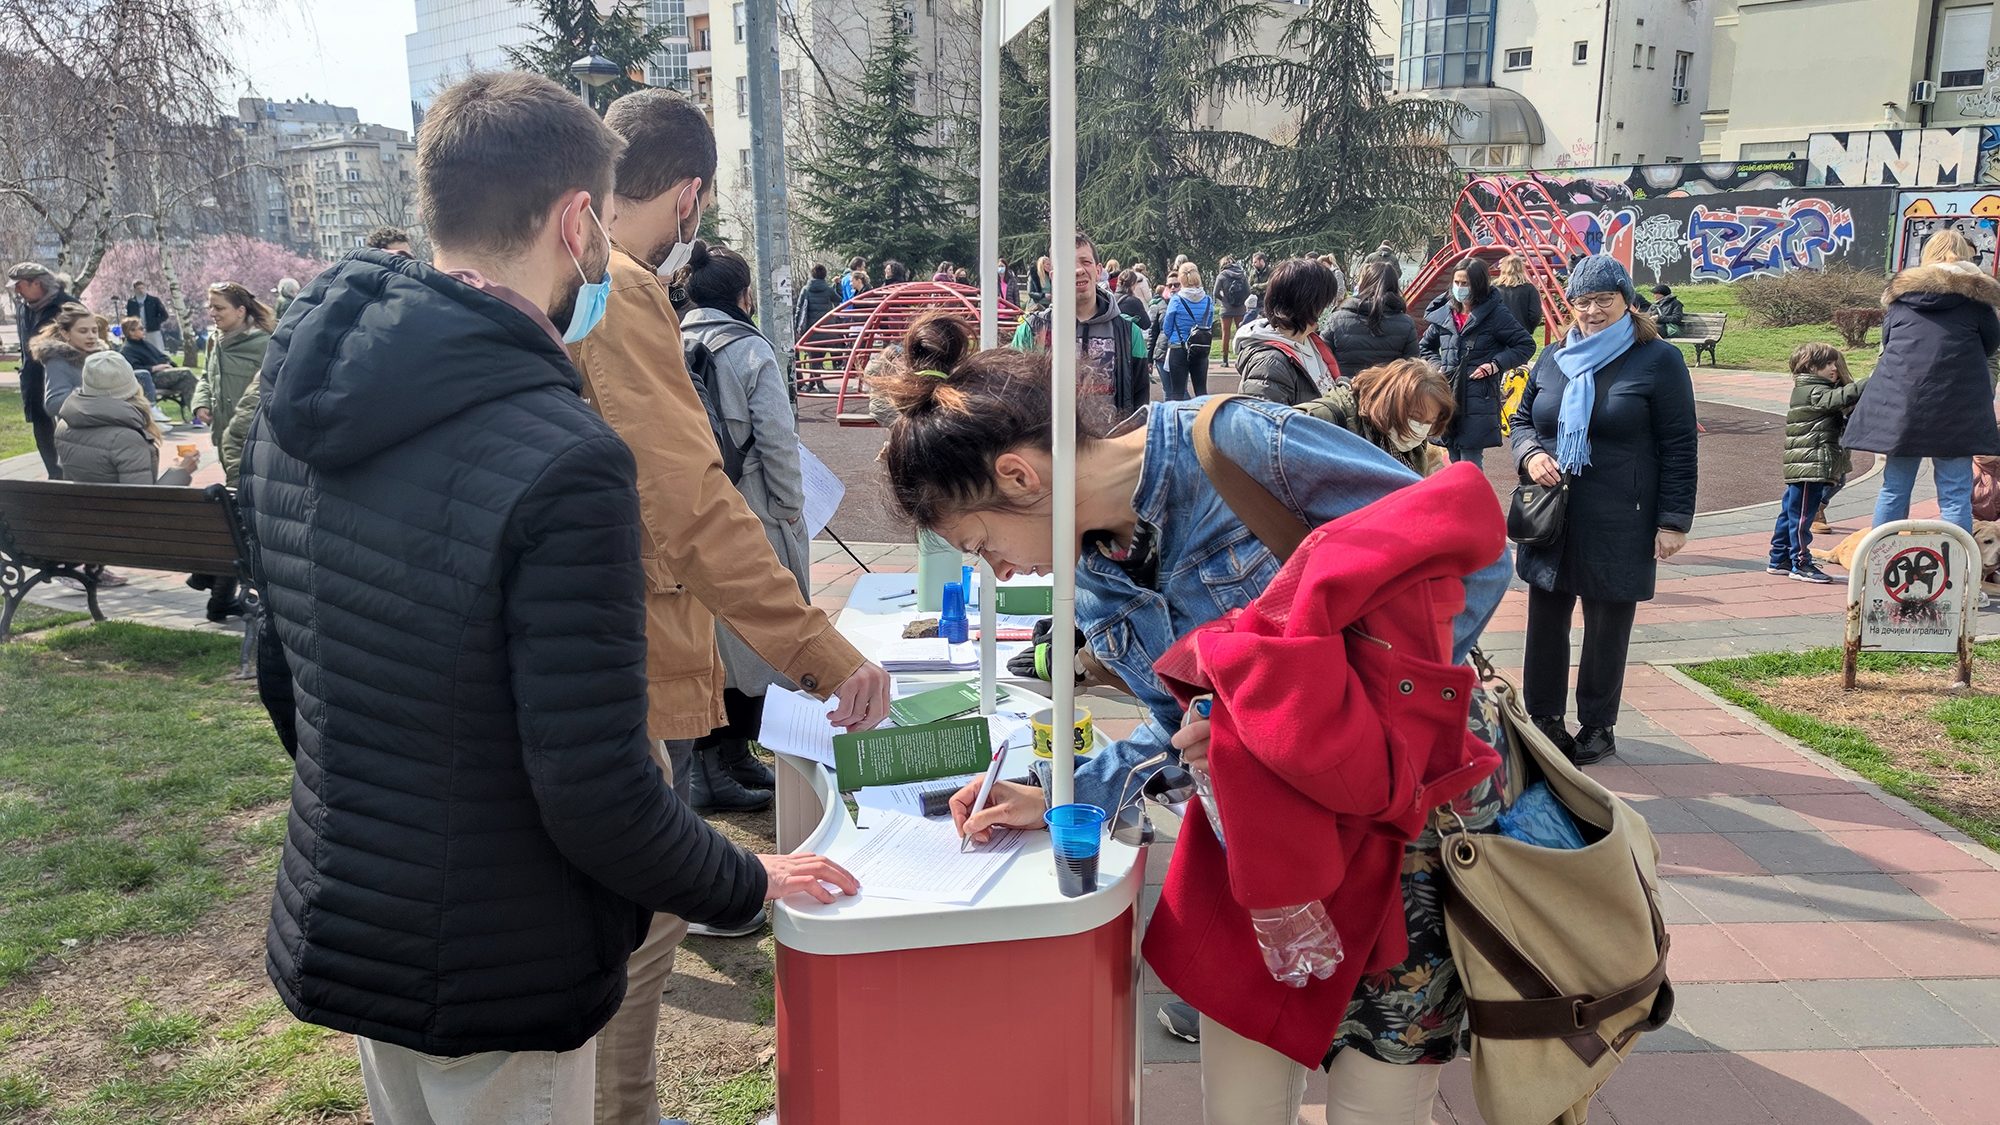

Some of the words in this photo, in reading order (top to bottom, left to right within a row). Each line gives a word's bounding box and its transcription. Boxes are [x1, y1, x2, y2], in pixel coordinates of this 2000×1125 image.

[1869, 625, 1880, 634] На
[1881, 626, 1911, 637] дечијем
[1912, 627, 1953, 637] игралишту
